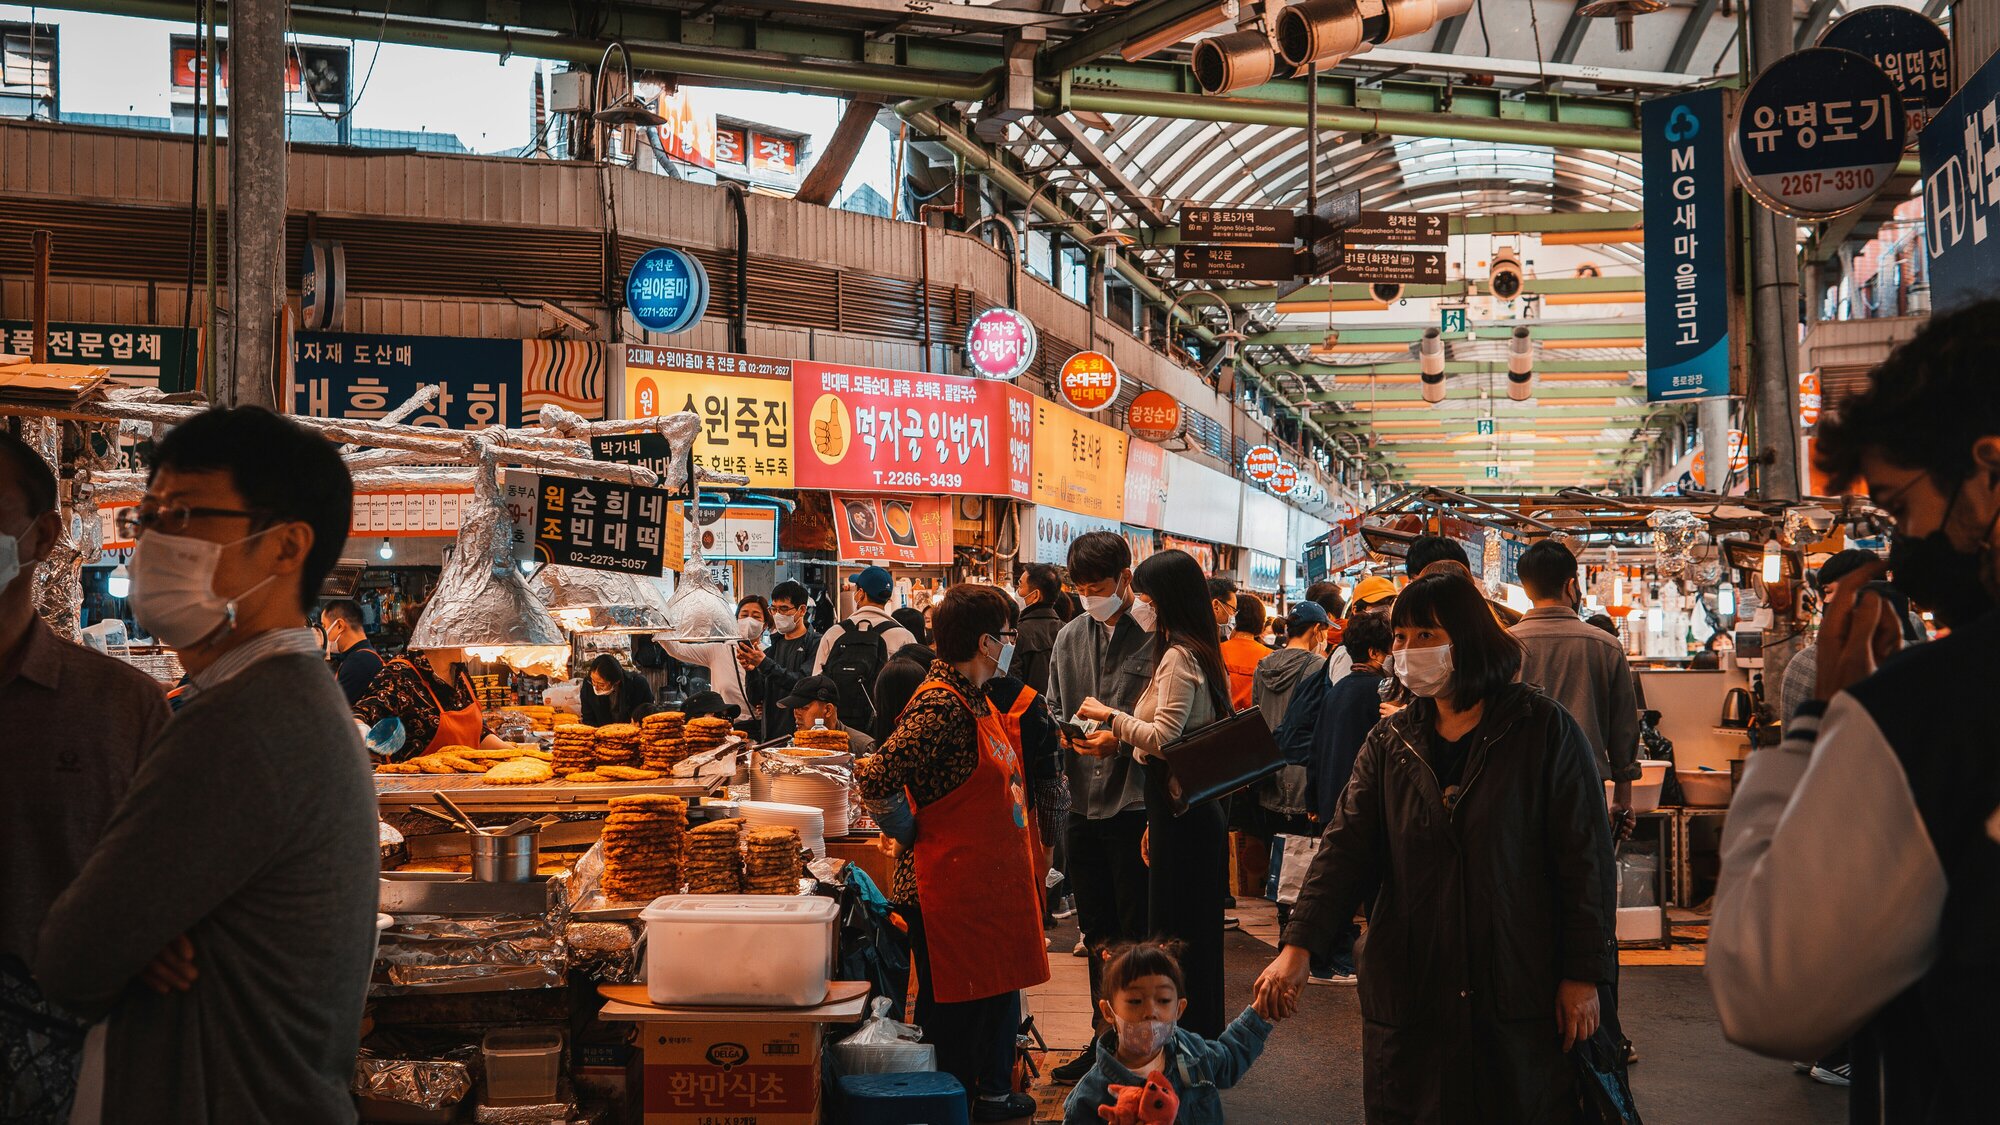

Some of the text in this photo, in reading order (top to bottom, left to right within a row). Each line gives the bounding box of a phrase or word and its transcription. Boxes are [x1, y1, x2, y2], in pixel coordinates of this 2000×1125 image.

[1874, 48, 1948, 92] 원떡집
[1748, 94, 1893, 153] 유명도기
[1781, 168, 1875, 196] 2267-3310
[1213, 212, 1254, 223] 종로5가역
[1388, 215, 1417, 227] 청계천
[1209, 250, 1233, 261] 북2문
[645, 259, 675, 272] 죽전문
[631, 278, 688, 300] 수원아줌마
[638, 307, 678, 317] 2271-2627
[980, 321, 1016, 337] 먹자골
[48, 330, 161, 360] 전문업체
[973, 338, 1021, 362] 일번지
[353, 344, 412, 367] 도산매
[628, 348, 654, 365] 2대째
[657, 350, 703, 370] 수원아줌마
[706, 355, 715, 371] 죽
[717, 356, 735, 372] 전문
[1072, 358, 1104, 371] 육회
[1065, 372, 1113, 387] 순대국밥
[1672, 374, 1703, 387] 종로광장
[1071, 388, 1107, 401] 빈대떡
[1009, 397, 1031, 437] 먹자골
[1132, 406, 1176, 425] 광장순대
[855, 405, 990, 467] 먹자골 일번지
[600, 439, 641, 456] 박가네
[1071, 428, 1102, 469] 종로식당
[873, 470, 962, 487] T.2266-3439
[507, 484, 536, 500] 동부A
[571, 486, 663, 525] 순희네
[570, 517, 661, 556] 빈대떡
[570, 551, 648, 570] 02-2273-5057
[714, 1050, 740, 1059] DELGA
[667, 1071, 787, 1108] 환만식초
